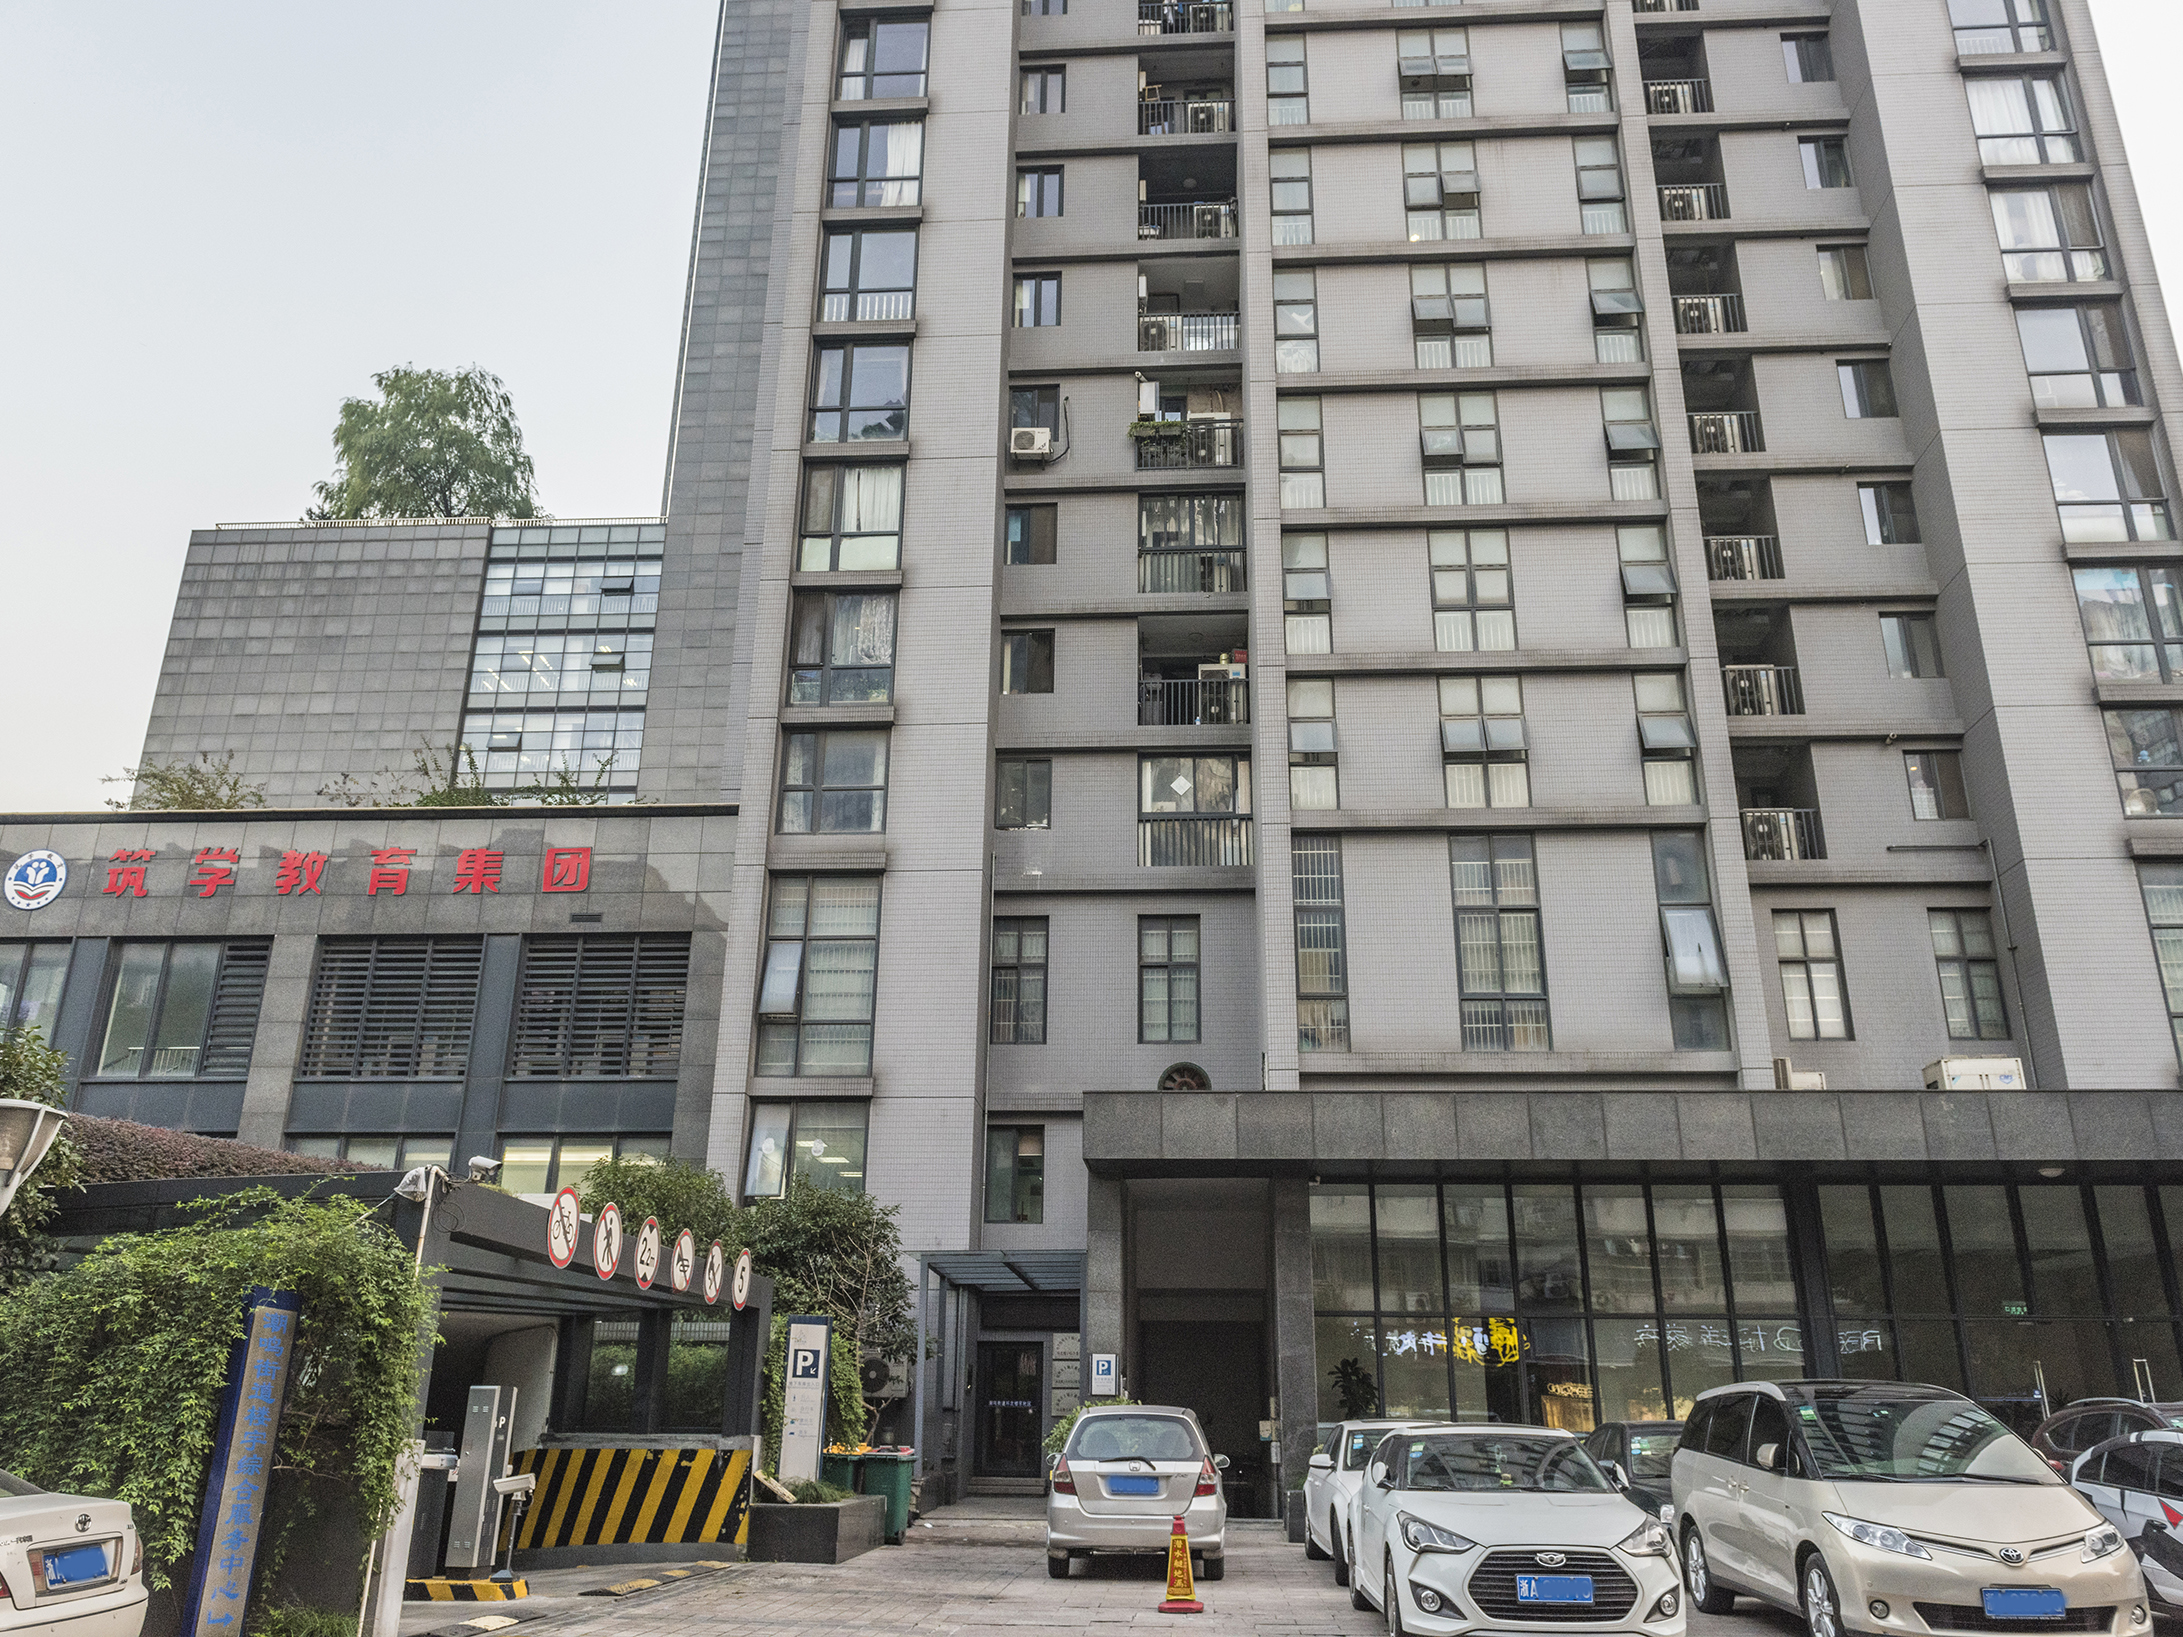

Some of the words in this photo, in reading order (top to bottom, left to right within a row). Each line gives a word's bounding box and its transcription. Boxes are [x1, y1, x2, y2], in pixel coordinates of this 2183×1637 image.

[102, 846, 593, 898] 筑学教育集团
[738, 1266, 746, 1293] 5
[796, 1350, 814, 1376] P
[1098, 1361, 1109, 1375] P
[211, 1312, 289, 1600] 潮鸣街道楼宇综合服务中心
